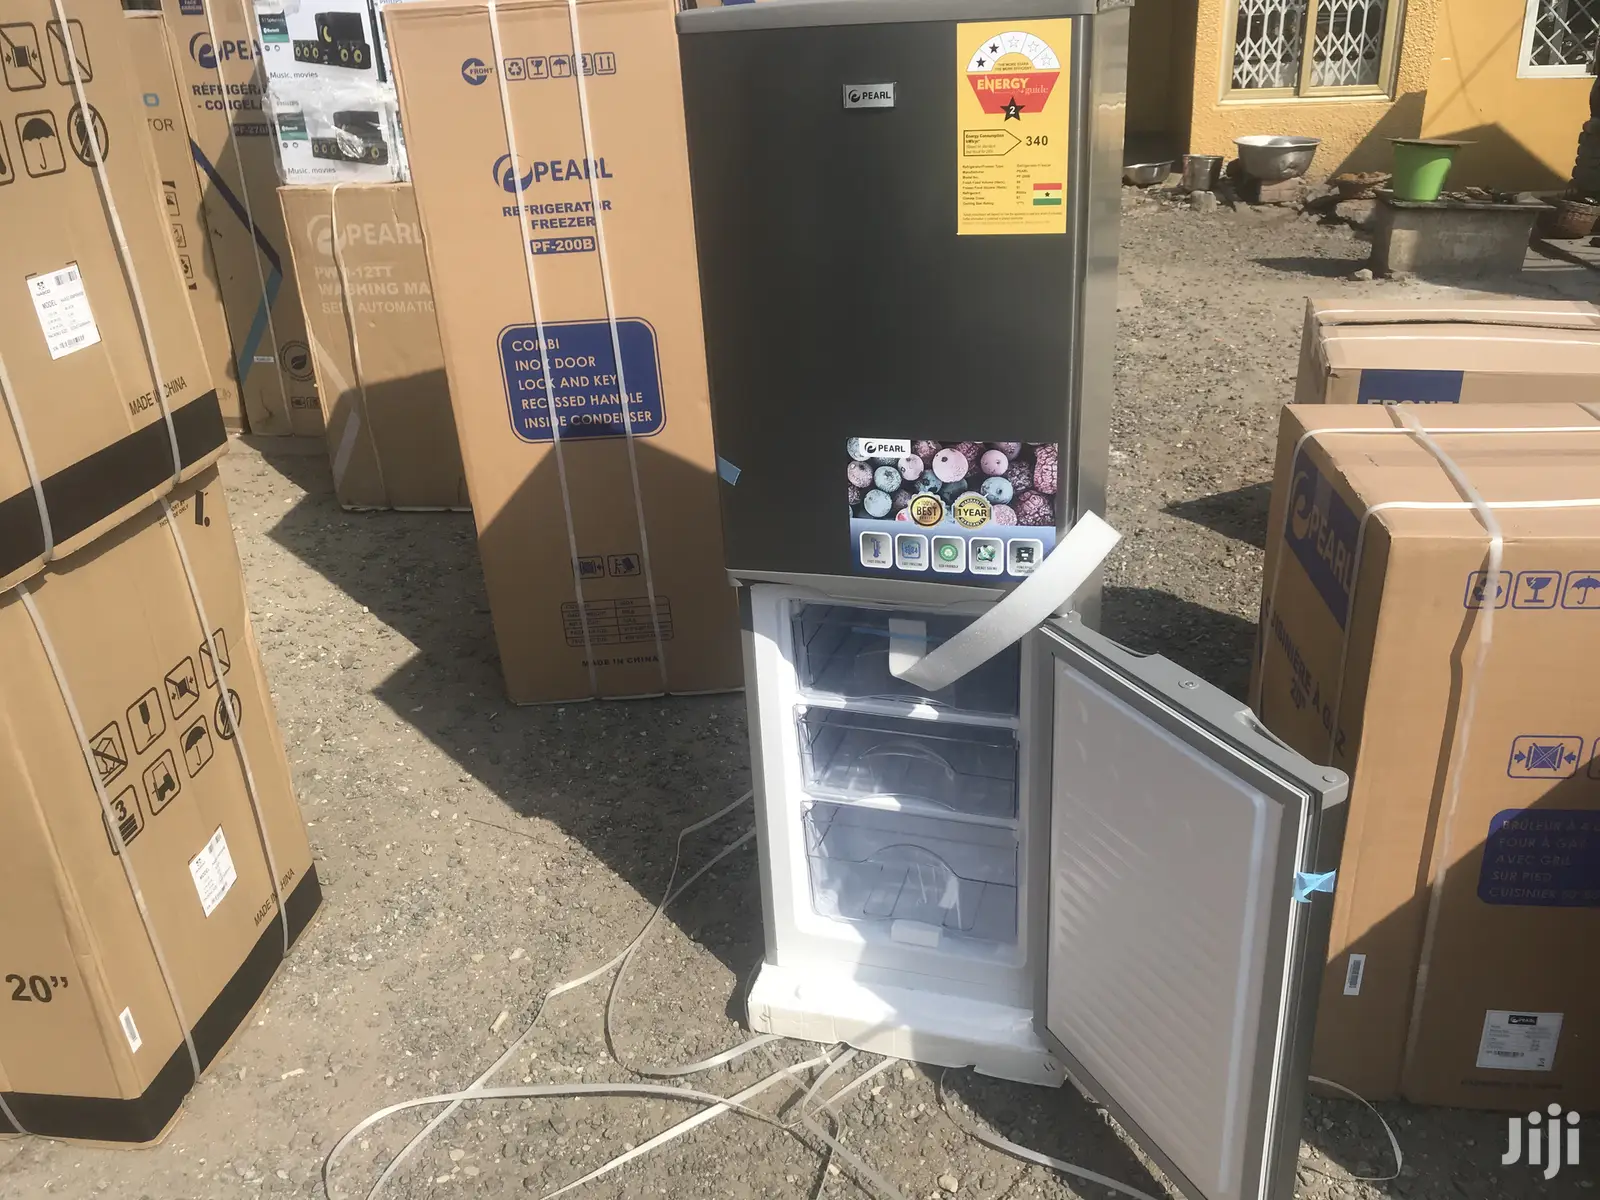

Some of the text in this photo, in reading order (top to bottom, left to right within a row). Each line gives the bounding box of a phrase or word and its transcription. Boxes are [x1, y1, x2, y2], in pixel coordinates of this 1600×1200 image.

[469, 67, 494, 75] FRONT
[977, 75, 1048, 95] ENERGY guide
[862, 91, 891, 100] PEARL
[1009, 106, 1016, 115] 2
[1025, 135, 1049, 146] 340
[531, 216, 596, 230] FREEZER
[346, 221, 423, 246] PEARL
[531, 238, 594, 253] PF-200B
[42, 299, 58, 309] MODEL
[555, 356, 596, 369] DOOR
[560, 376, 590, 388] AND
[593, 374, 617, 386] KEY
[129, 392, 154, 416] MADE
[522, 396, 586, 410] RECSSED
[878, 444, 906, 453] PEARL
[916, 506, 937, 516] BEST
[1495, 854, 1535, 865] AVEC
[1492, 870, 1518, 881] SUR
[253, 899, 272, 927] MADE
[280, 868, 295, 892] HINA
